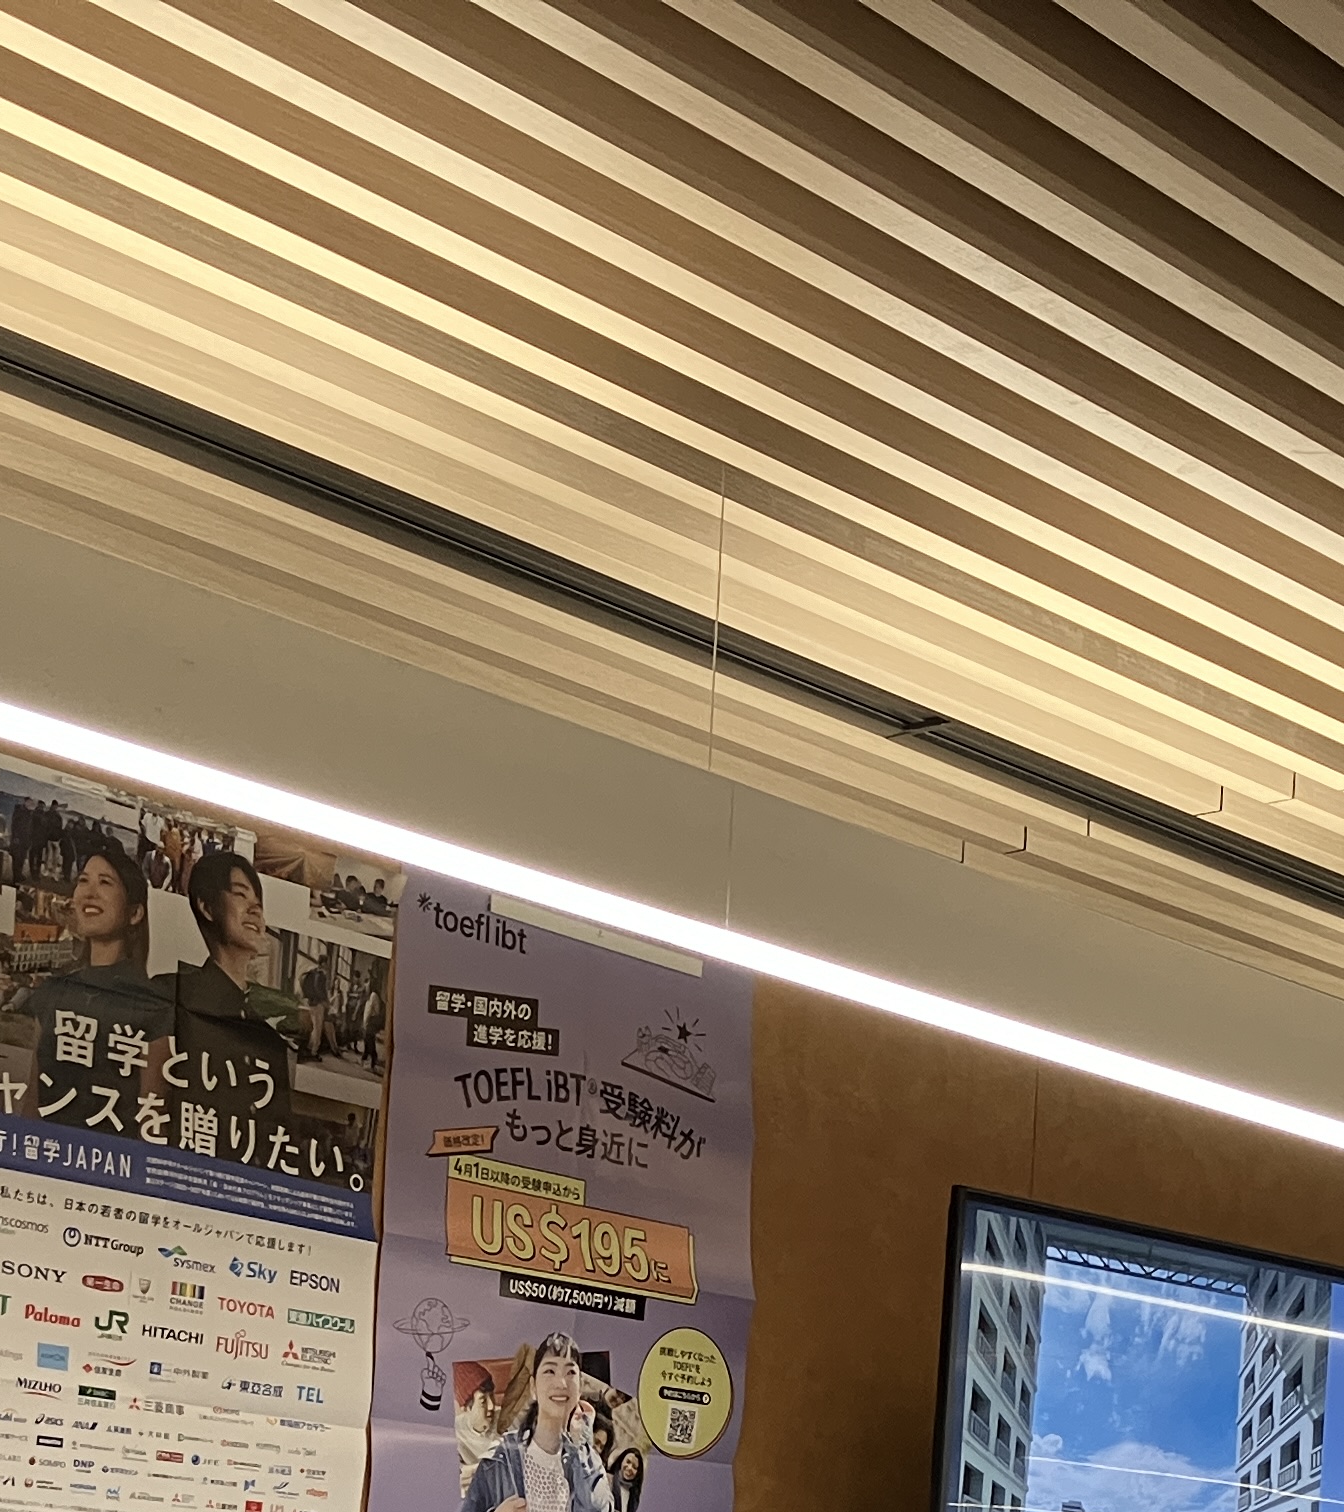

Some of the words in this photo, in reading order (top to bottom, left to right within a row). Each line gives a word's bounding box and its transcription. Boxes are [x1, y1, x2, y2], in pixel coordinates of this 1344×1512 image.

[433, 901, 490, 941] toefl
[495, 918, 527, 955] ibt
[435, 990, 532, 1020] 留学・国内外の
[473, 1024, 553, 1051] 進学を応援！
[55, 1010, 275, 1110] 留学という
[505, 1109, 649, 1169] もっと身近に
[453, 1158, 580, 1201] 4月1日以降の受験申込から
[1, 1260, 68, 1284] SONY
[172, 1258, 216, 1275] sysmex
[245, 1261, 278, 1285] Sky
[290, 1269, 341, 1294] EPSON
[24, 1304, 82, 1329] Paloma
[218, 1296, 275, 1320] TOYOTA
[94, 1310, 129, 1335] JR
[141, 1323, 204, 1346] HITACHI
[215, 1330, 270, 1361] FUJITSU
[15, 1376, 62, 1394] MIZUHO
[296, 1385, 325, 1405] TEL
[73, 1458, 95, 1469] DNP
